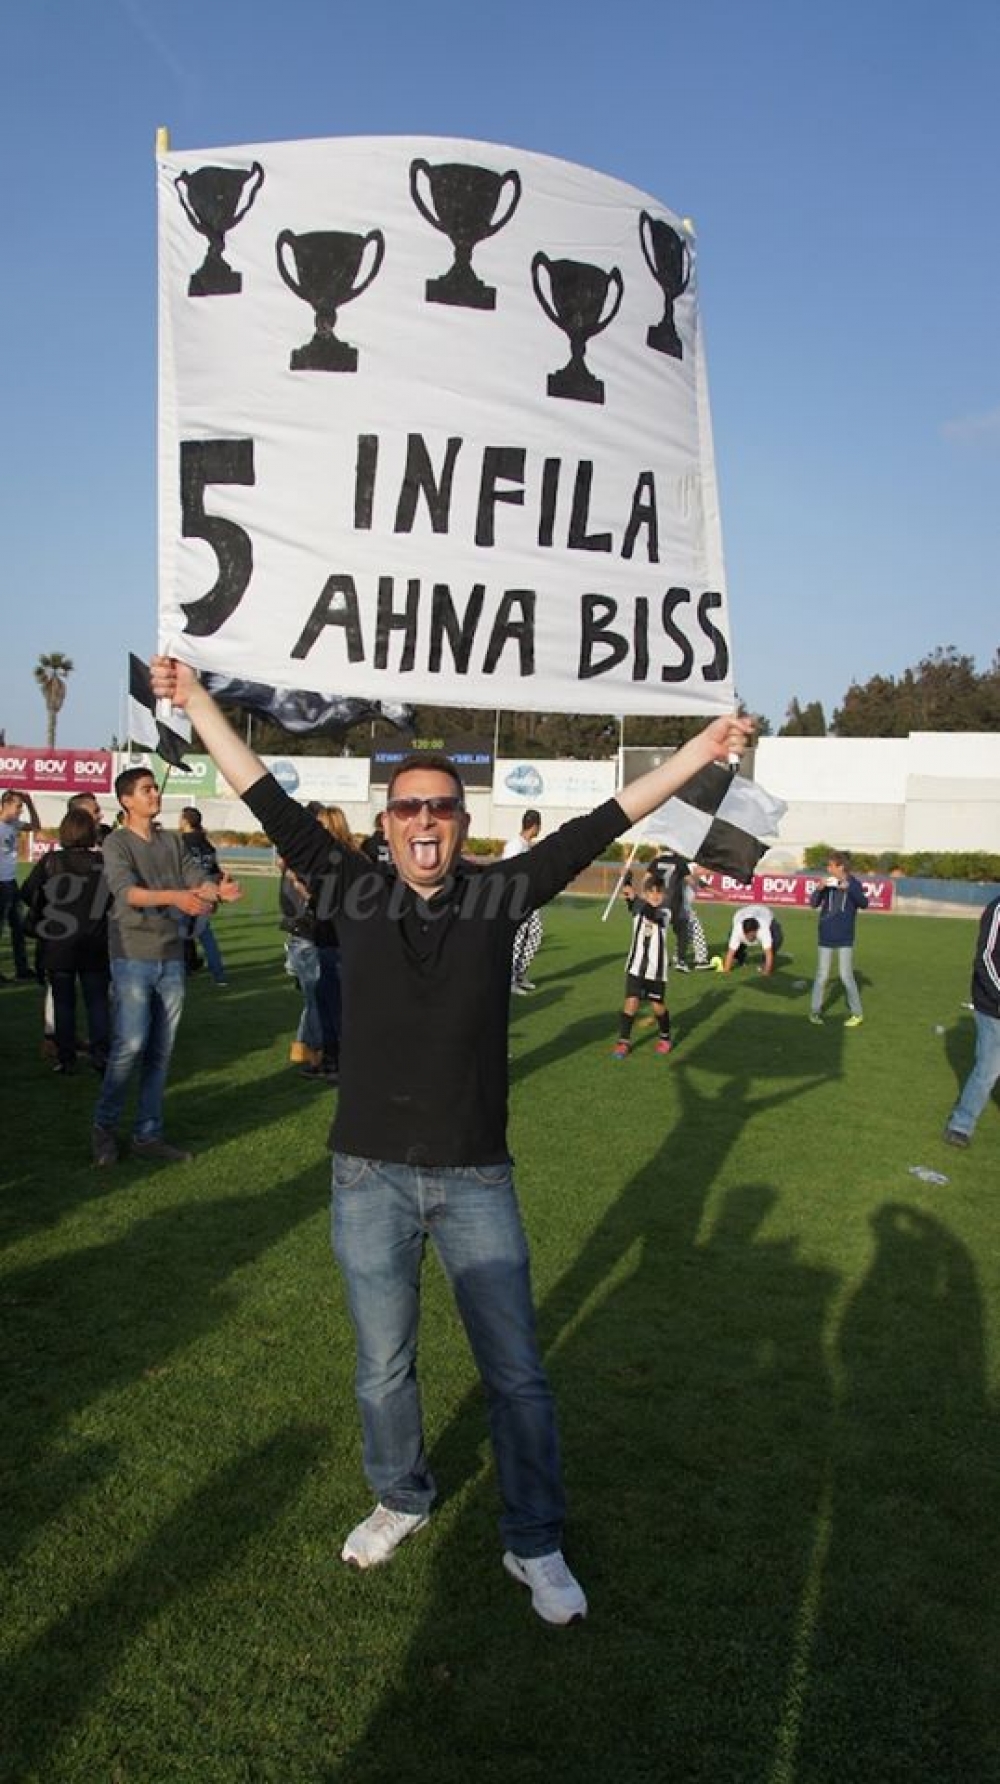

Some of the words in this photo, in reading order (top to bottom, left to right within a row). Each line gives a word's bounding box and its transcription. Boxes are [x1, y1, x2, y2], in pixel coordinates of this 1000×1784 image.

[354, 433, 660, 563] INFILA
[180, 438, 255, 637] 5
[290, 574, 536, 677] AHNA
[577, 587, 729, 682] BISS
[34, 759, 67, 773] BOV
[74, 761, 107, 774] BOV
[657, 861, 676, 889] 7
[763, 878, 797, 893] BOV
